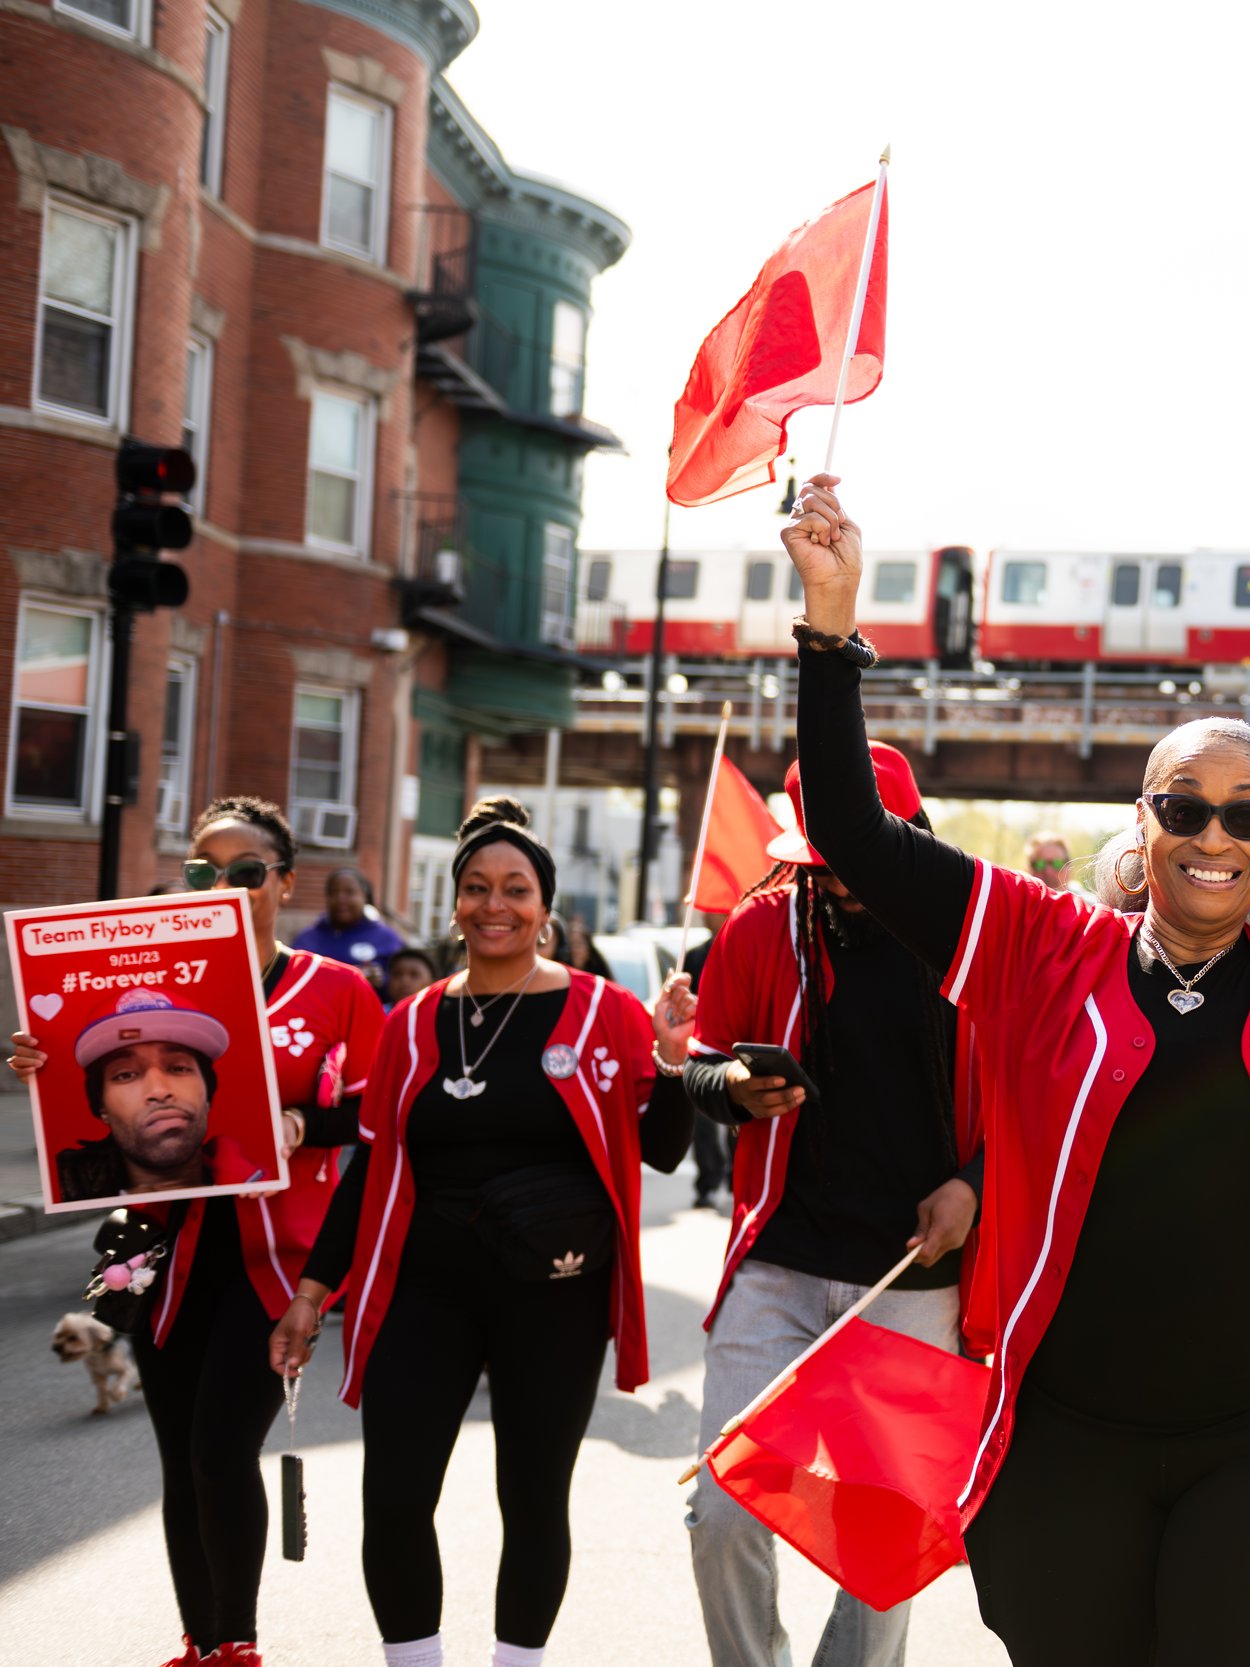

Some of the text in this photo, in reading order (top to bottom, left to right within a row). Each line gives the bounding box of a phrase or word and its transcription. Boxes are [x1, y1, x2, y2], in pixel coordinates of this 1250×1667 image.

[30, 928, 85, 945] Team
[90, 919, 156, 942] Flyboy
[109, 950, 160, 967] 9/11/23
[62, 959, 208, 993] #Forever 37
